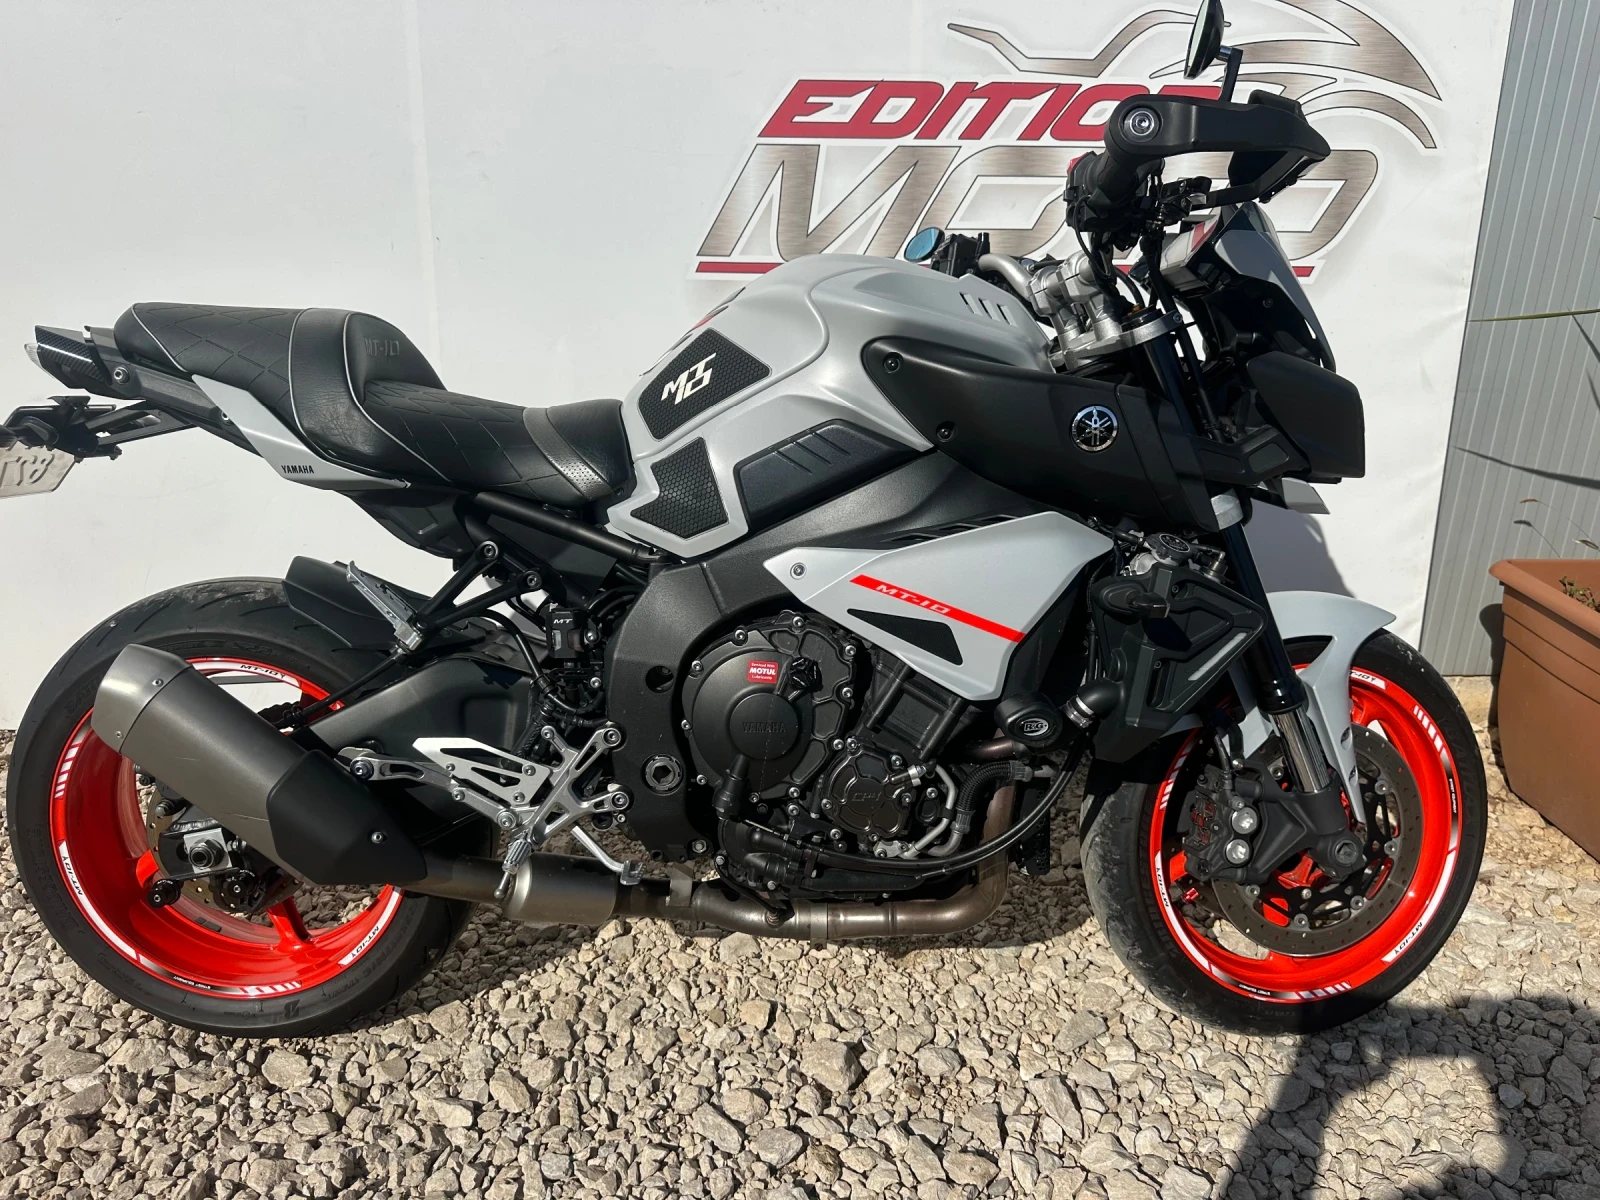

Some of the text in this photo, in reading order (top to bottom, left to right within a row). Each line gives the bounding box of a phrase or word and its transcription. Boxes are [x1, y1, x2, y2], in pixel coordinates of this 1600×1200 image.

[758, 79, 1223, 141] EDITIO
[364, 338, 400, 357] MT-10
[280, 464, 315, 474] YAMAHA
[875, 584, 951, 614] MT-10
[749, 667, 776, 676] MOTUL
[742, 721, 786, 733] YAMAHA
